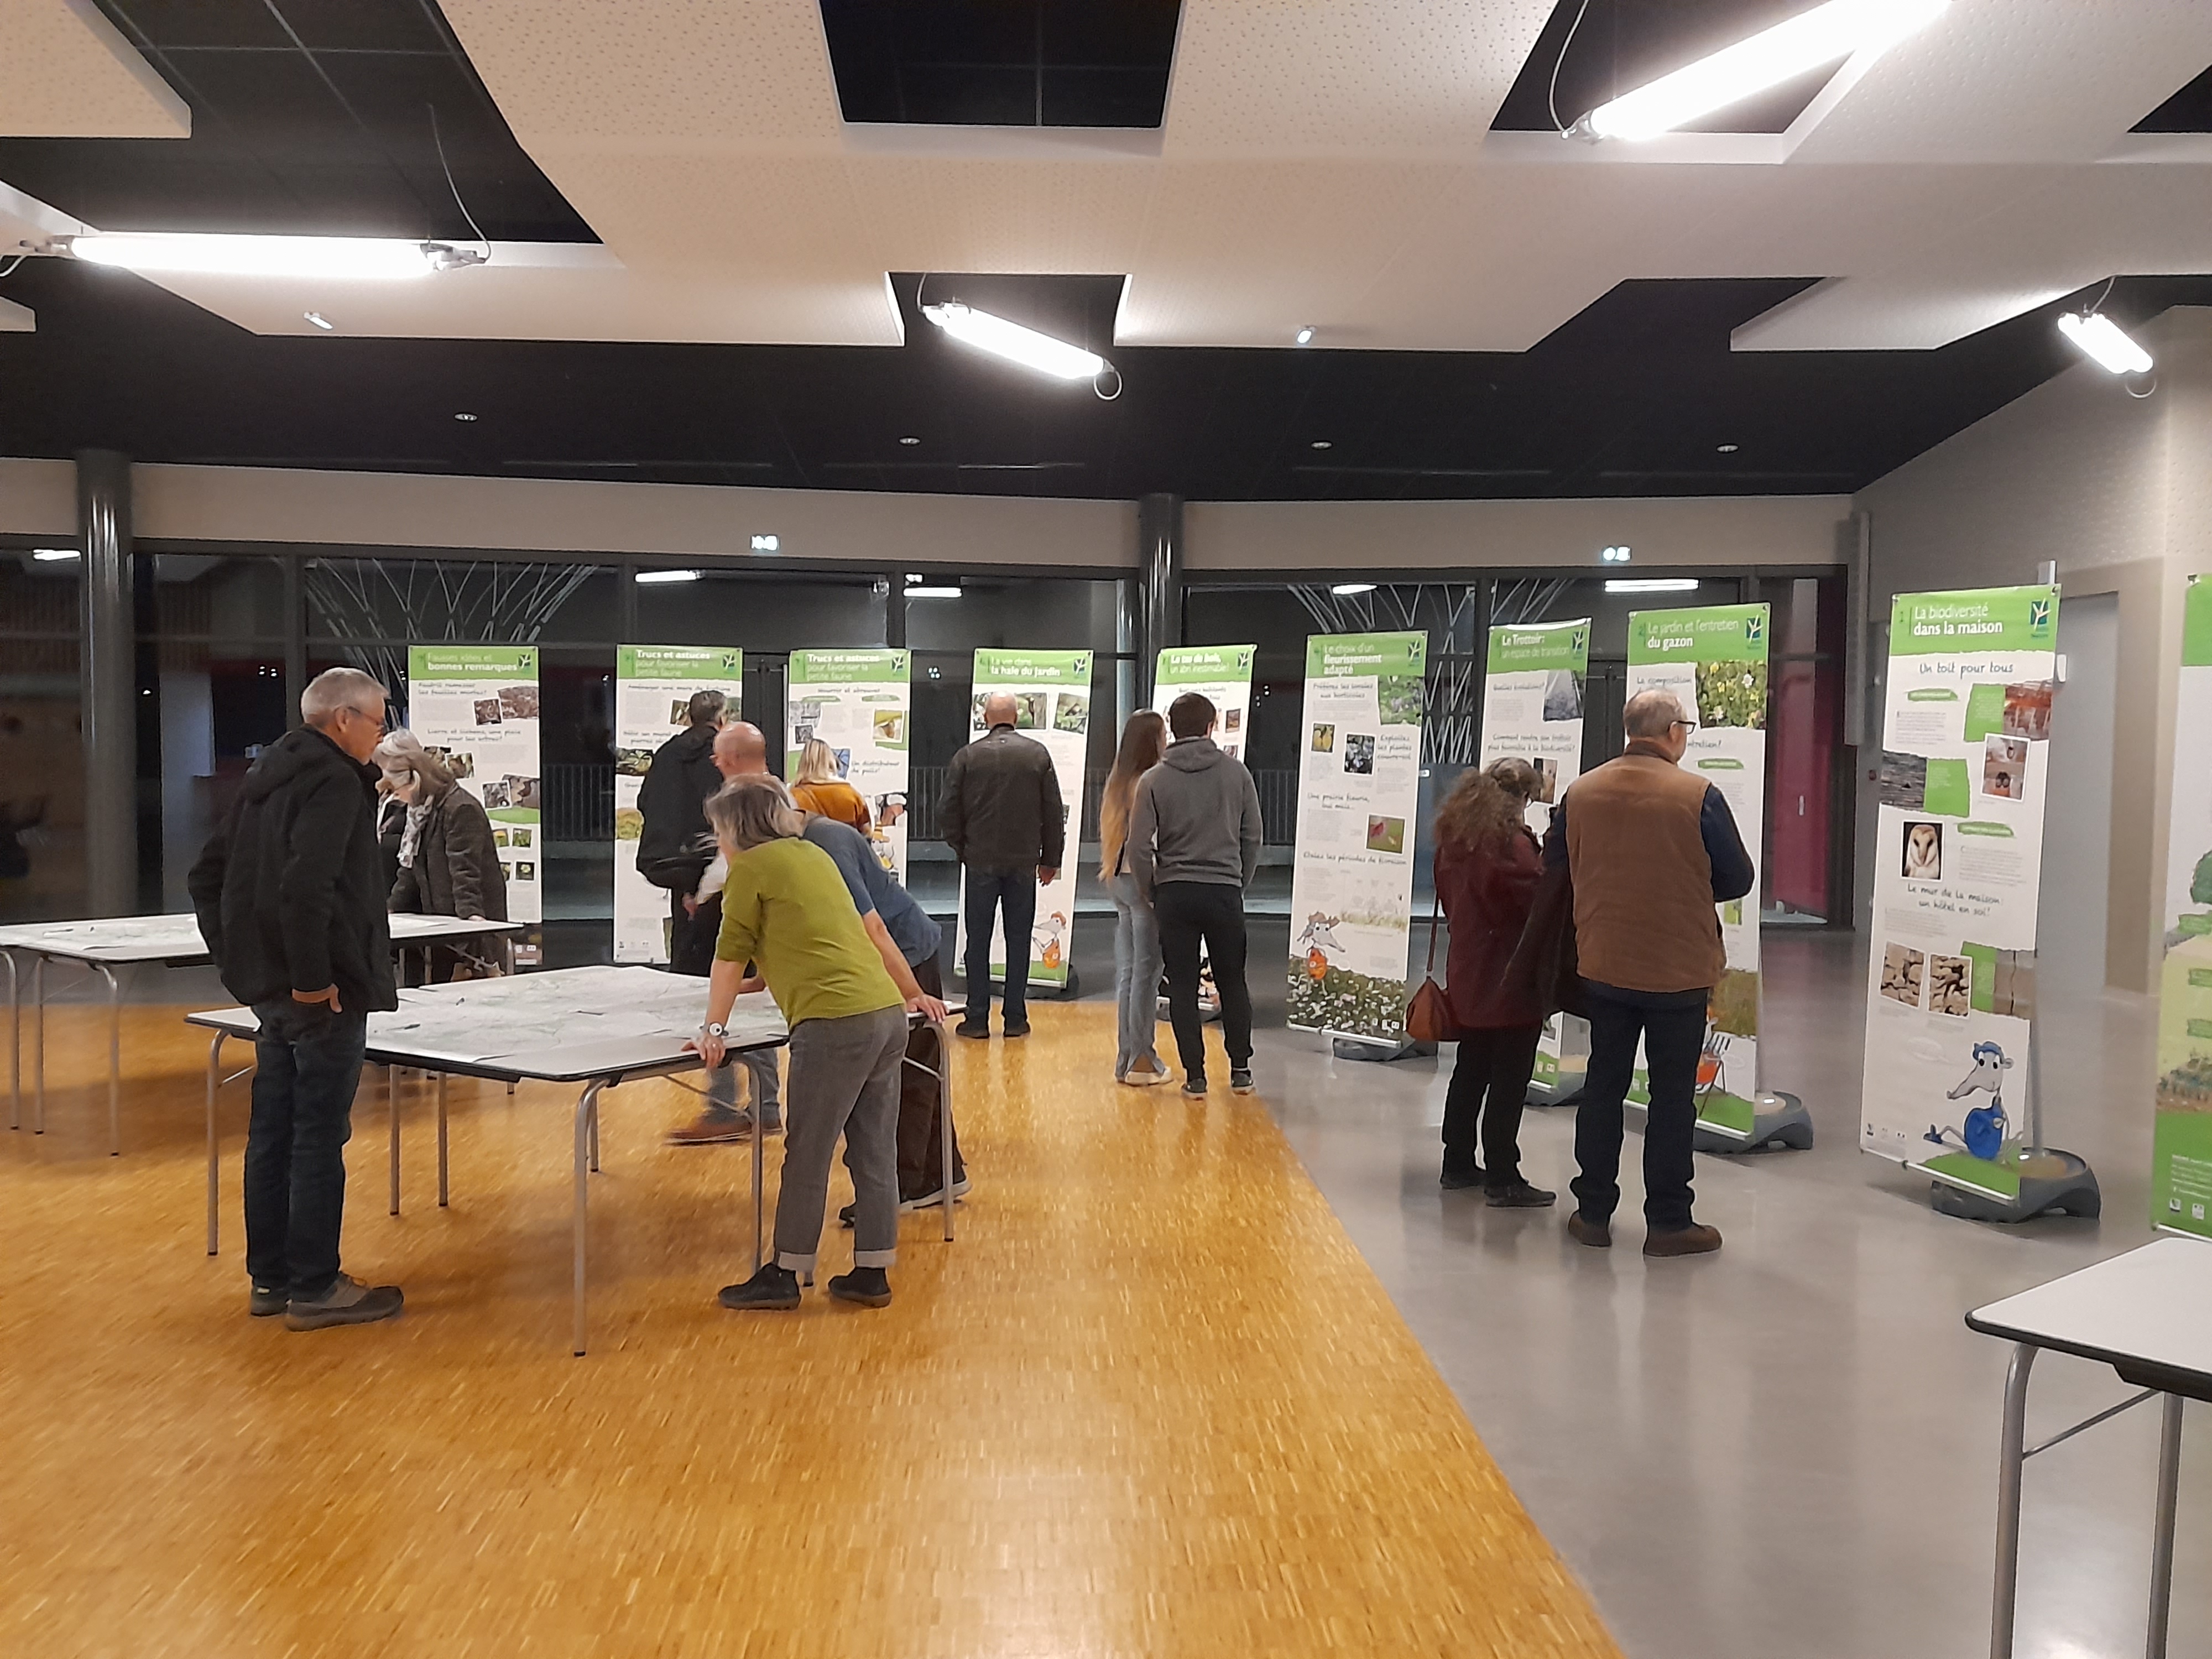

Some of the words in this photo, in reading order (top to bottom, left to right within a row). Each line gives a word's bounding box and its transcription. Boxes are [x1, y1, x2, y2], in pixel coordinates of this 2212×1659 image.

[1915, 607, 1926, 619] La
[1929, 602, 1989, 619] biodiversité
[1648, 623, 1658, 634] Le
[1660, 620, 1683, 635] jardin
[1684, 622, 1694, 632] et
[1696, 619, 1738, 630] l'entretien
[1913, 622, 1940, 636] dans
[1944, 621, 1954, 634] la
[1958, 619, 2003, 634] maison
[1502, 635, 1511, 646] Le
[1512, 633, 1545, 645] Trottoir:
[1648, 636, 1660, 648] du
[1663, 637, 1693, 651] gazon
[1335, 644, 1355, 654] choix
[1358, 643, 1374, 652] d'un
[637, 650, 661, 659] Trucs
[675, 651, 710, 659] astuces
[1171, 654, 1180, 664] Le
[1324, 655, 1382, 664] fleurissement
[428, 662, 462, 670] bonnes
[465, 663, 517, 672] remarques
[1001, 666, 1019, 675] haie
[1034, 667, 1060, 677] jardin
[1324, 665, 1353, 676] adapté
[1919, 663, 1932, 673] Un
[1937, 662, 1955, 673] toit
[1960, 665, 1985, 680] pour
[1990, 661, 2013, 673] tous
[1647, 676, 1692, 686] composition
[1908, 884, 1917, 893] Le
[1921, 887, 1938, 895] mur
[1942, 888, 1952, 898] de
[1956, 890, 1964, 899] la
